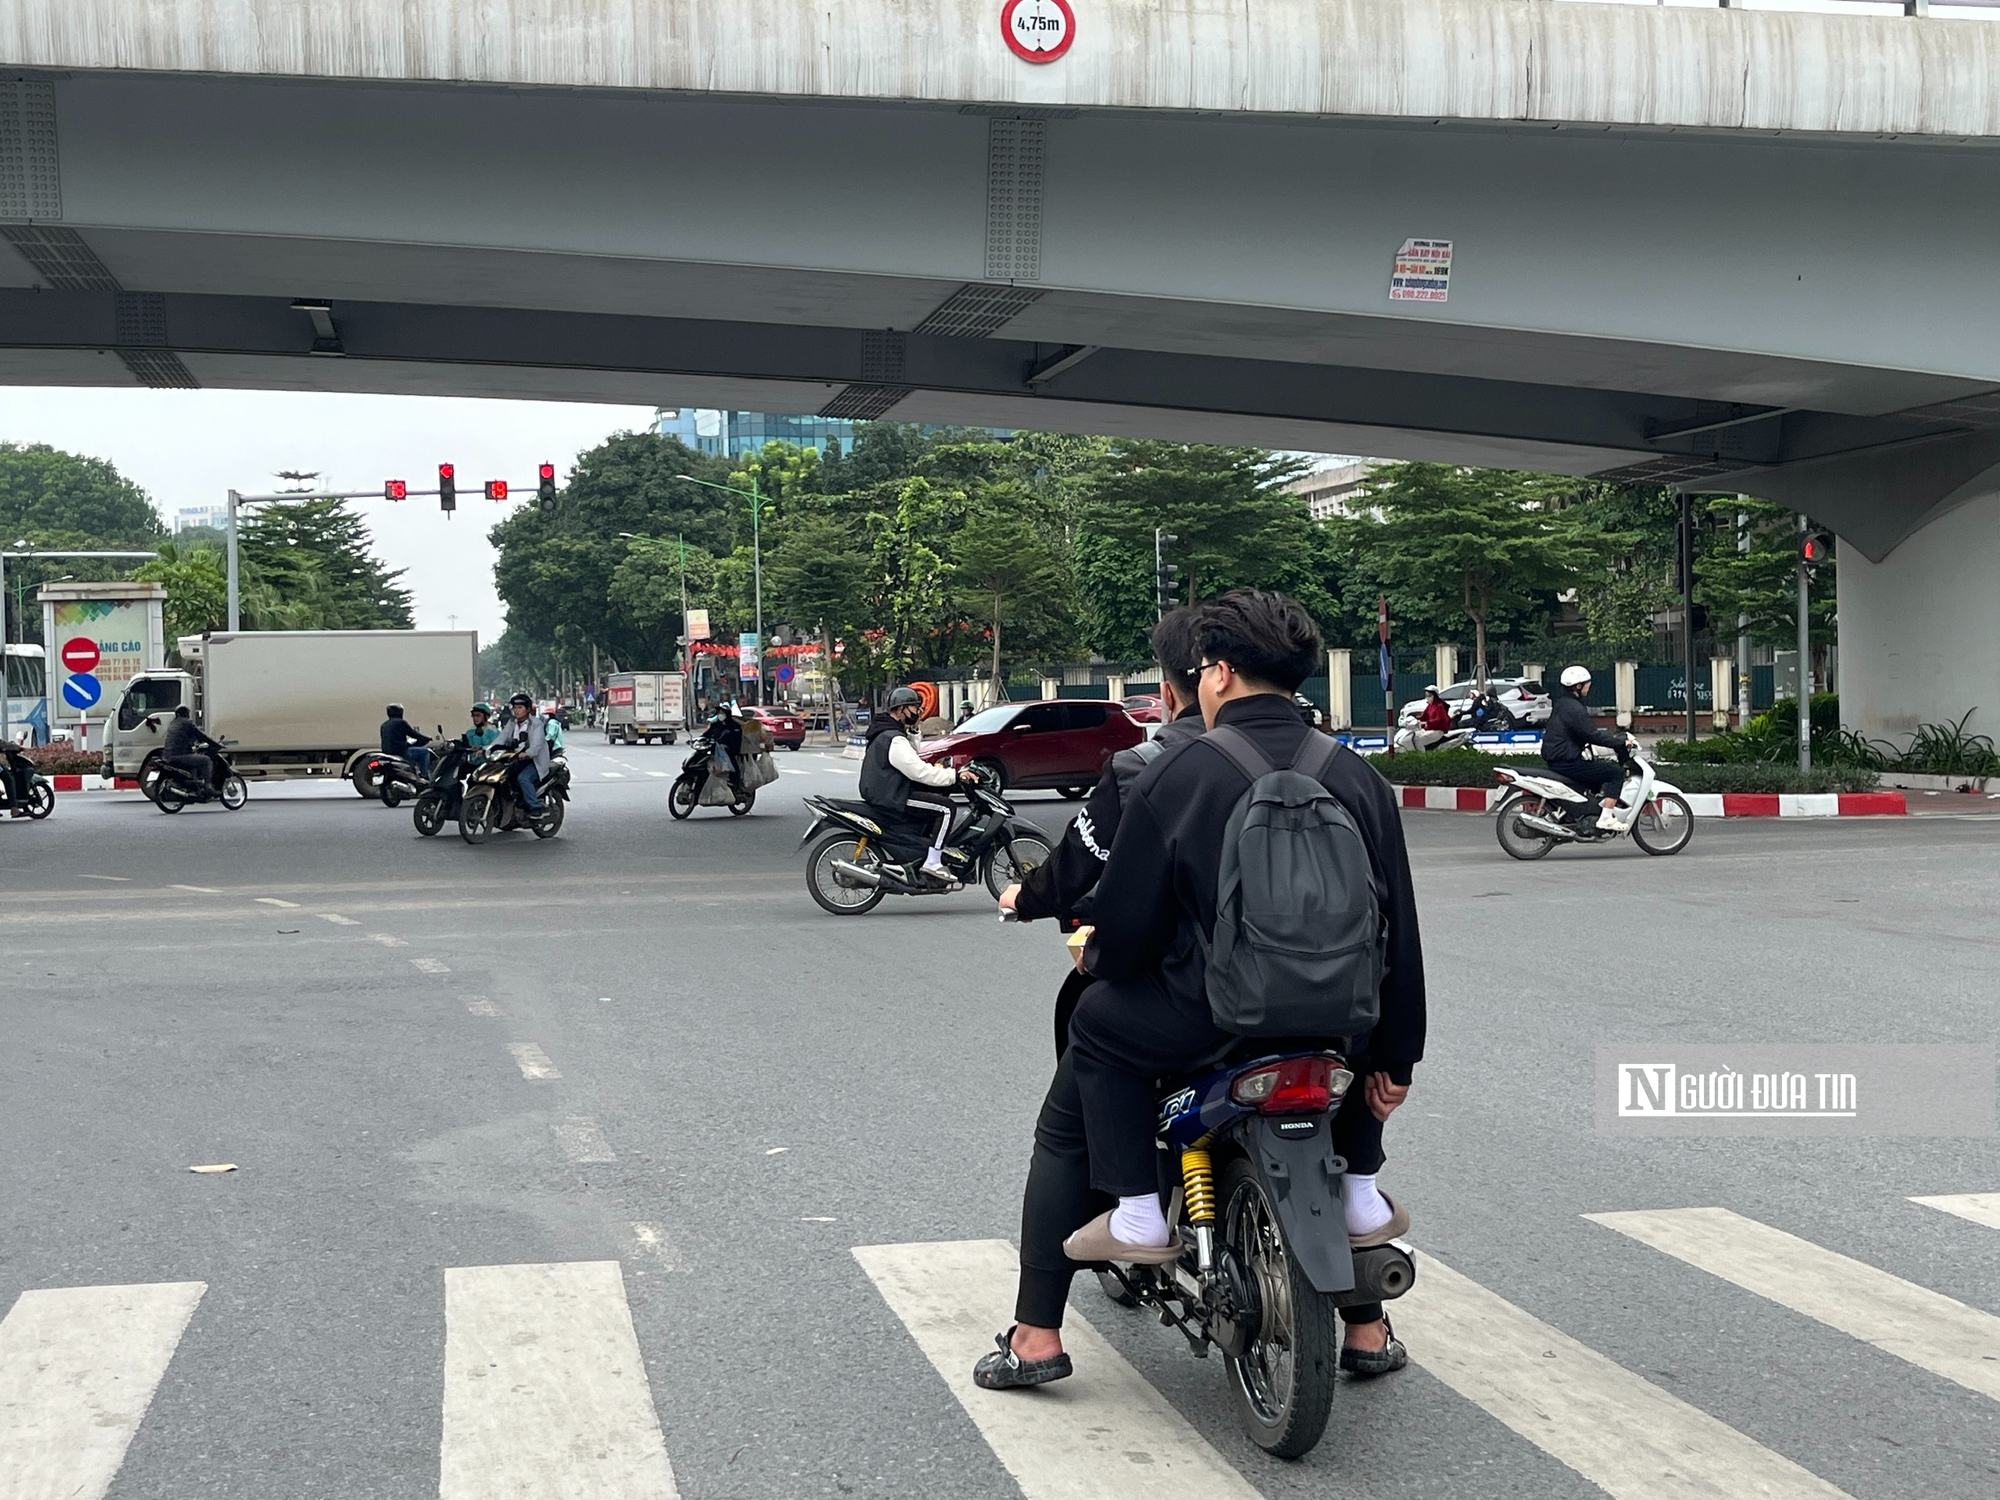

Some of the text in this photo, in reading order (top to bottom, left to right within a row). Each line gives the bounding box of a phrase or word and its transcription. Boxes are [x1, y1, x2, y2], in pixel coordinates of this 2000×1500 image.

[1017, 16, 1060, 32] 4,75m
[98, 639, 141, 652] ẢNG CÁO
[1280, 1121, 1314, 1130] HONDA
